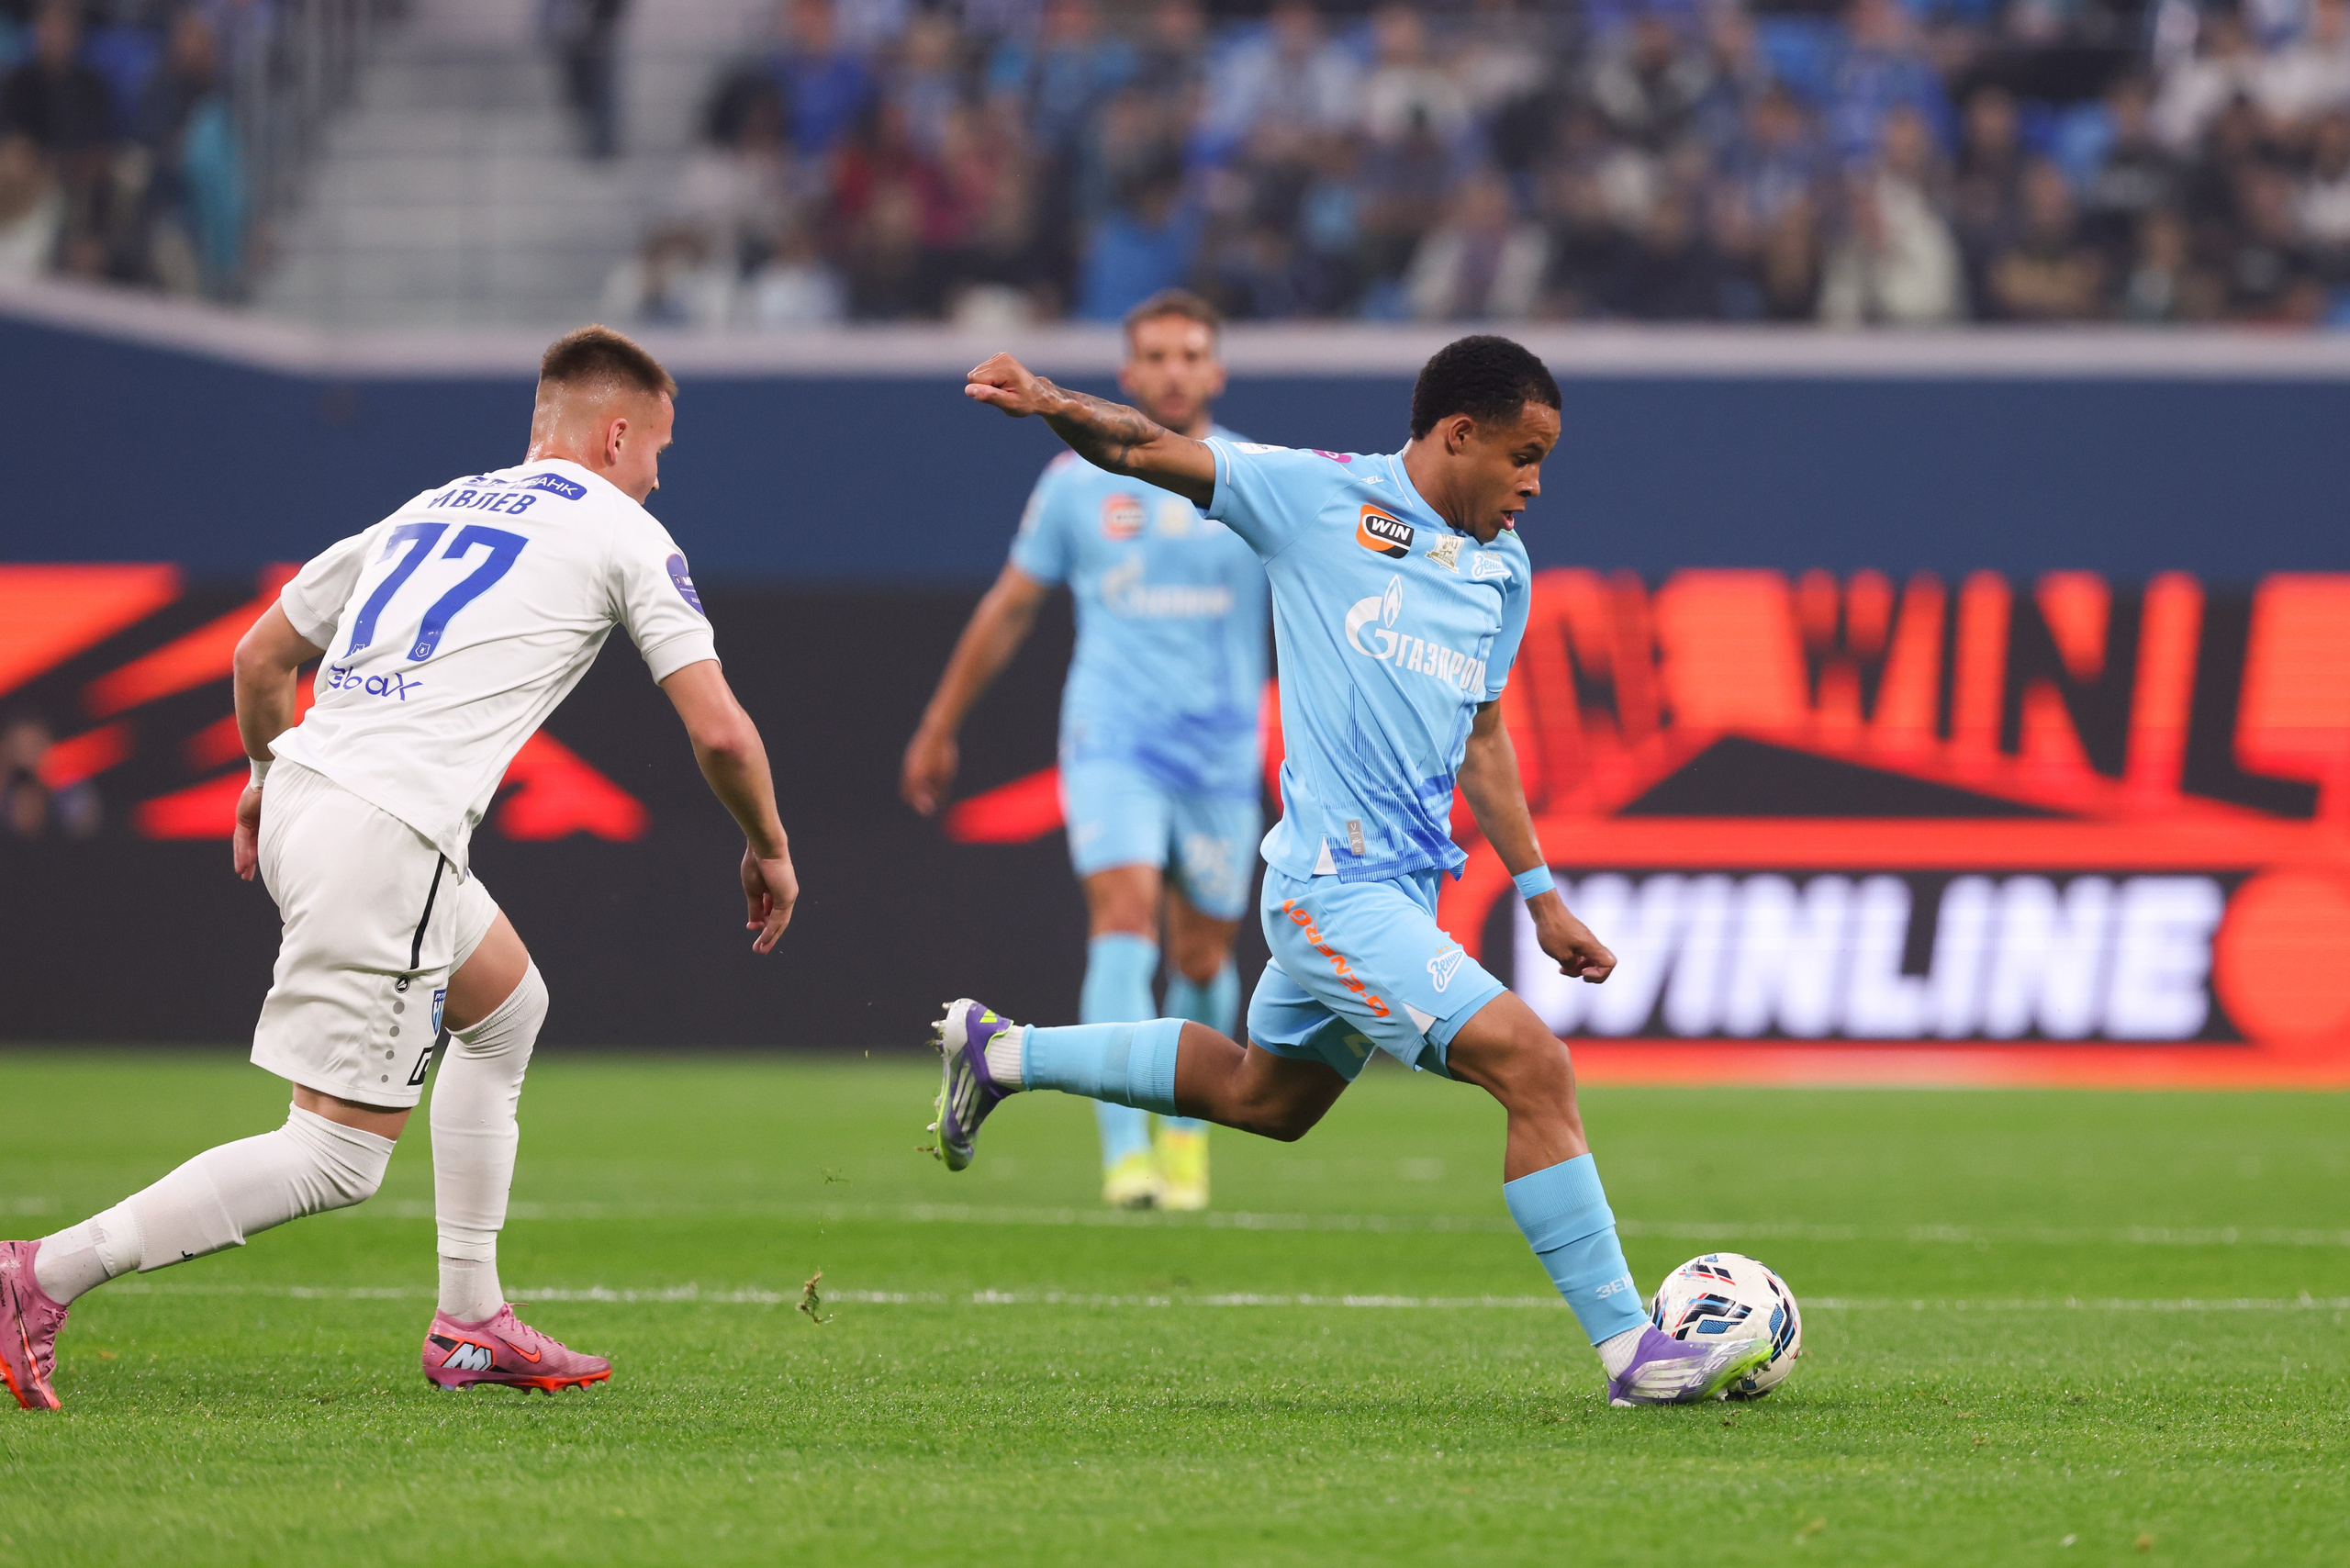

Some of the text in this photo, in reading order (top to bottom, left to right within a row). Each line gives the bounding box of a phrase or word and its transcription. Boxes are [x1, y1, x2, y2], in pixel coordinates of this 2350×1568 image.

[1371, 518, 1411, 541] WIN
[343, 521, 530, 662] 77
[1395, 633, 1486, 695] ГАЗПРОМ
[1514, 874, 2223, 1039] WINLINE
